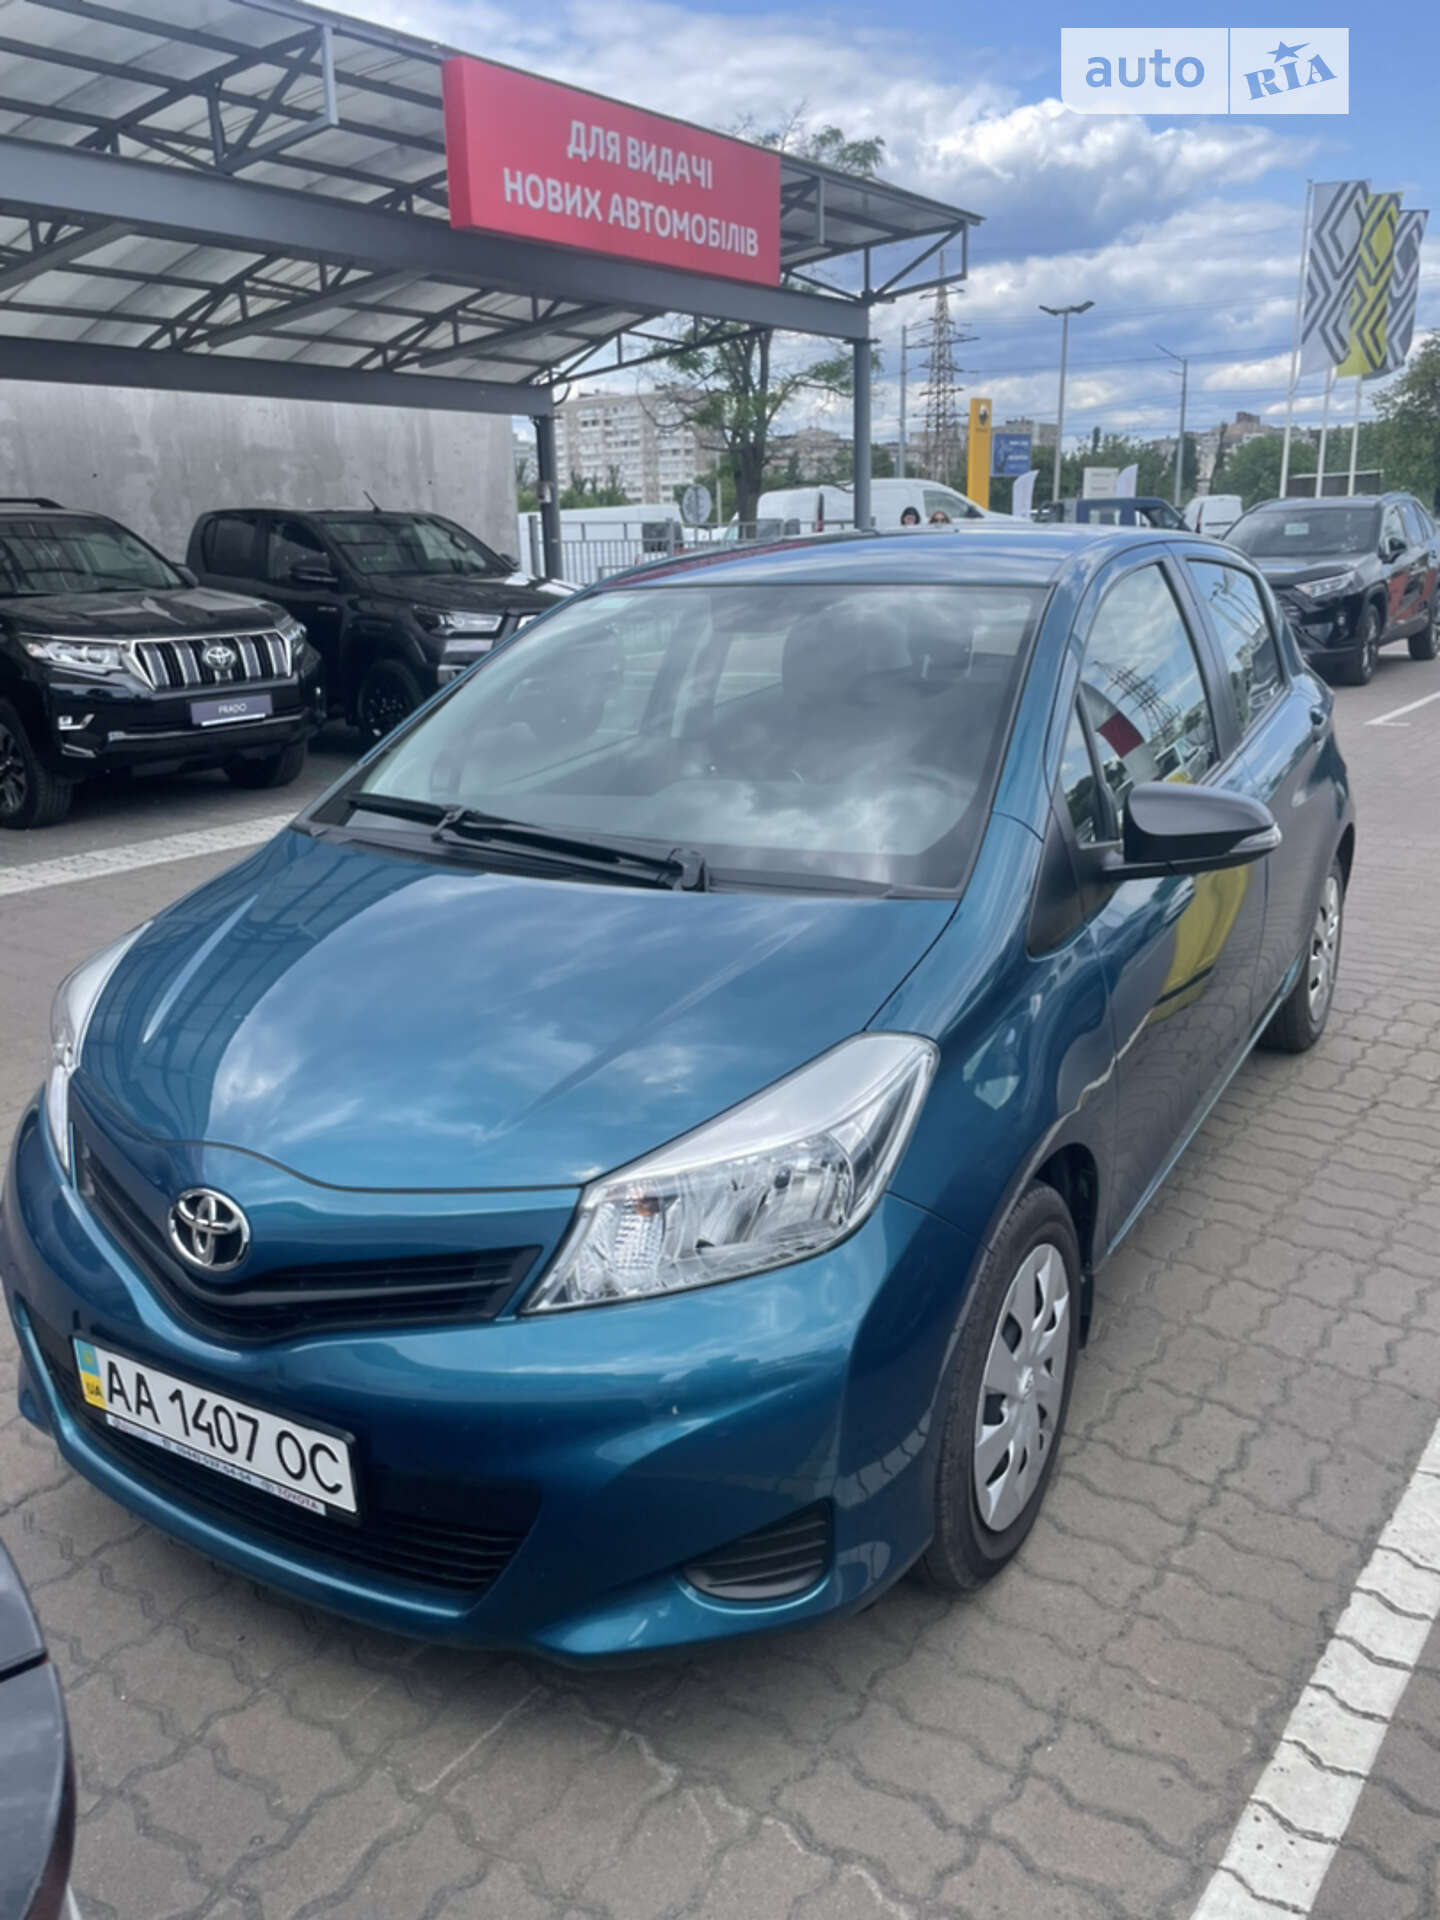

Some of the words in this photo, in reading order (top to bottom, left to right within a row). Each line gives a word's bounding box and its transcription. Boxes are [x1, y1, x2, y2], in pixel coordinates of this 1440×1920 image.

[567, 119, 621, 165] ДЛЯ
[626, 136, 713, 190] ВИДАЧІ
[503, 167, 603, 222] НОВИХ
[608, 193, 759, 257] АВТОМОБІЛІВ
[108, 1361, 160, 1424] AA
[169, 1388, 260, 1463] 1407
[277, 1431, 342, 1494] OC
